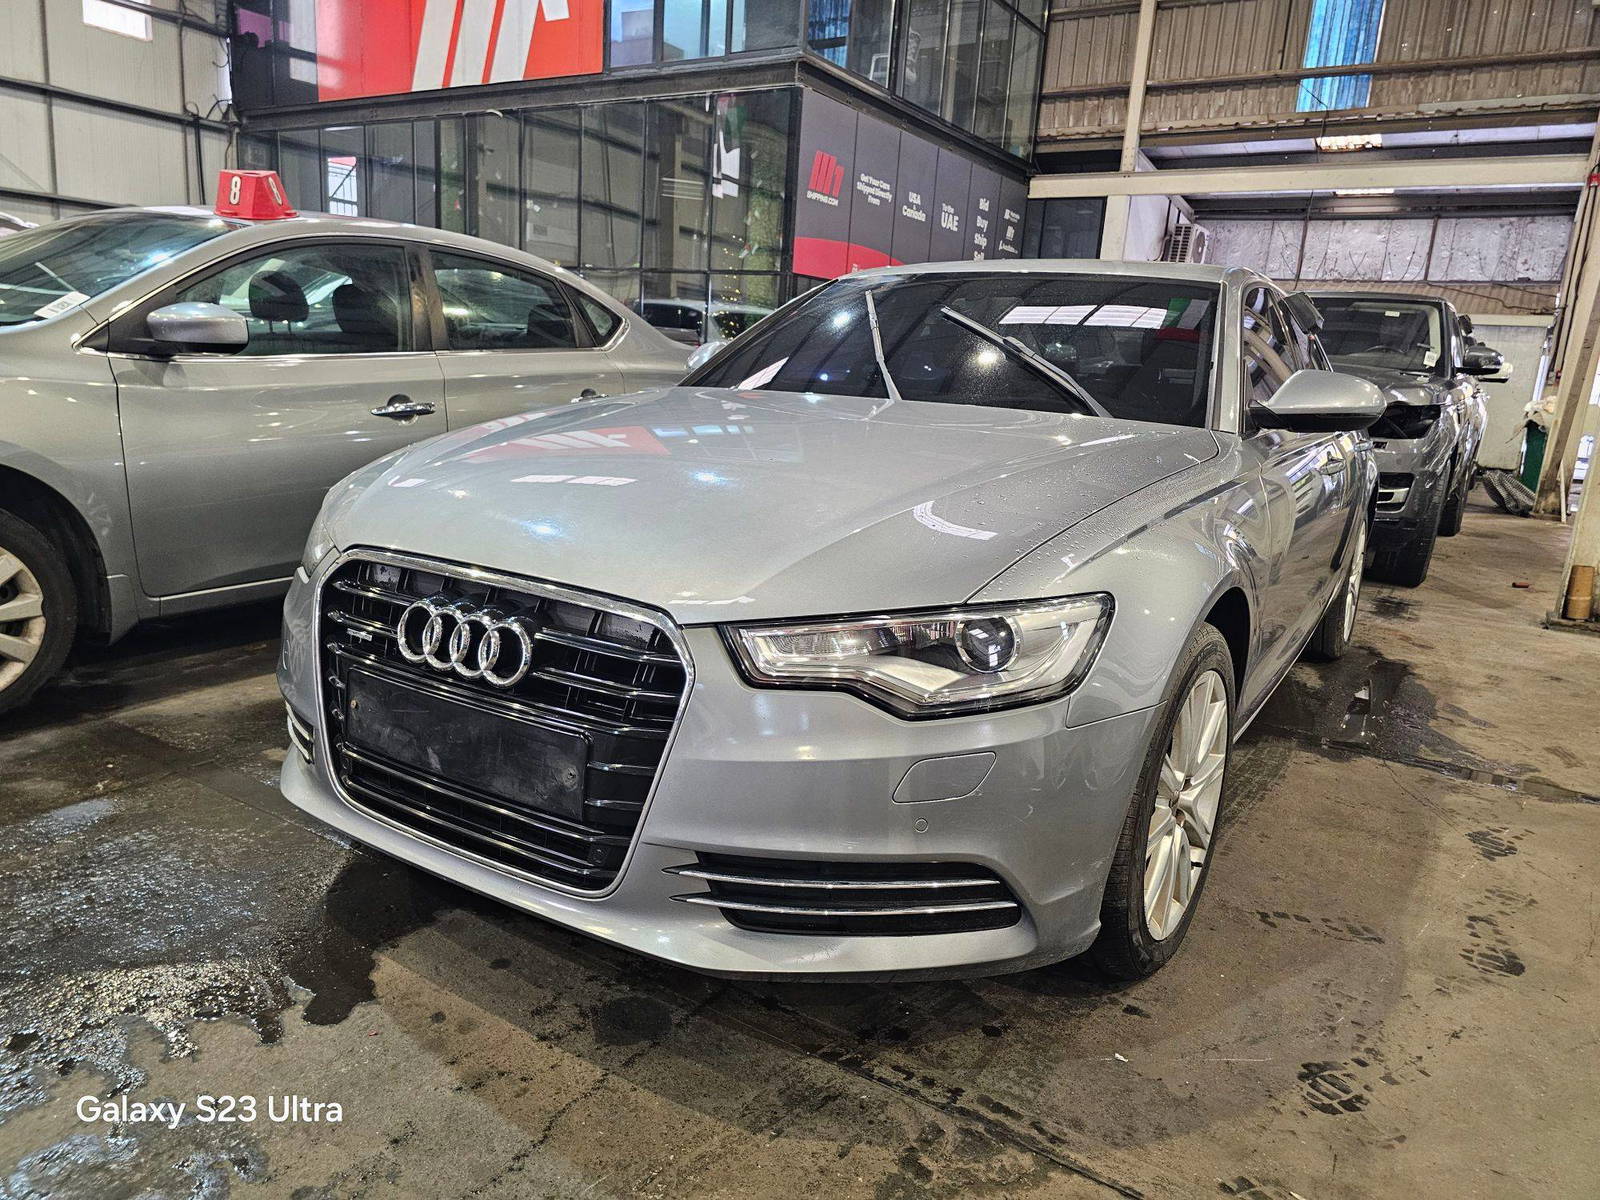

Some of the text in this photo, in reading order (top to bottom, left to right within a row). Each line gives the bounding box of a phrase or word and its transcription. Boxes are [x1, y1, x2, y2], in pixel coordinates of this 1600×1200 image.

[230, 176, 241, 205] 8
[909, 191, 921, 205] USA
[979, 198, 990, 211] Bid
[902, 205, 926, 222] Canada
[941, 211, 959, 231] UAE
[976, 215, 989, 232] Buy
[974, 233, 987, 249] Ship
